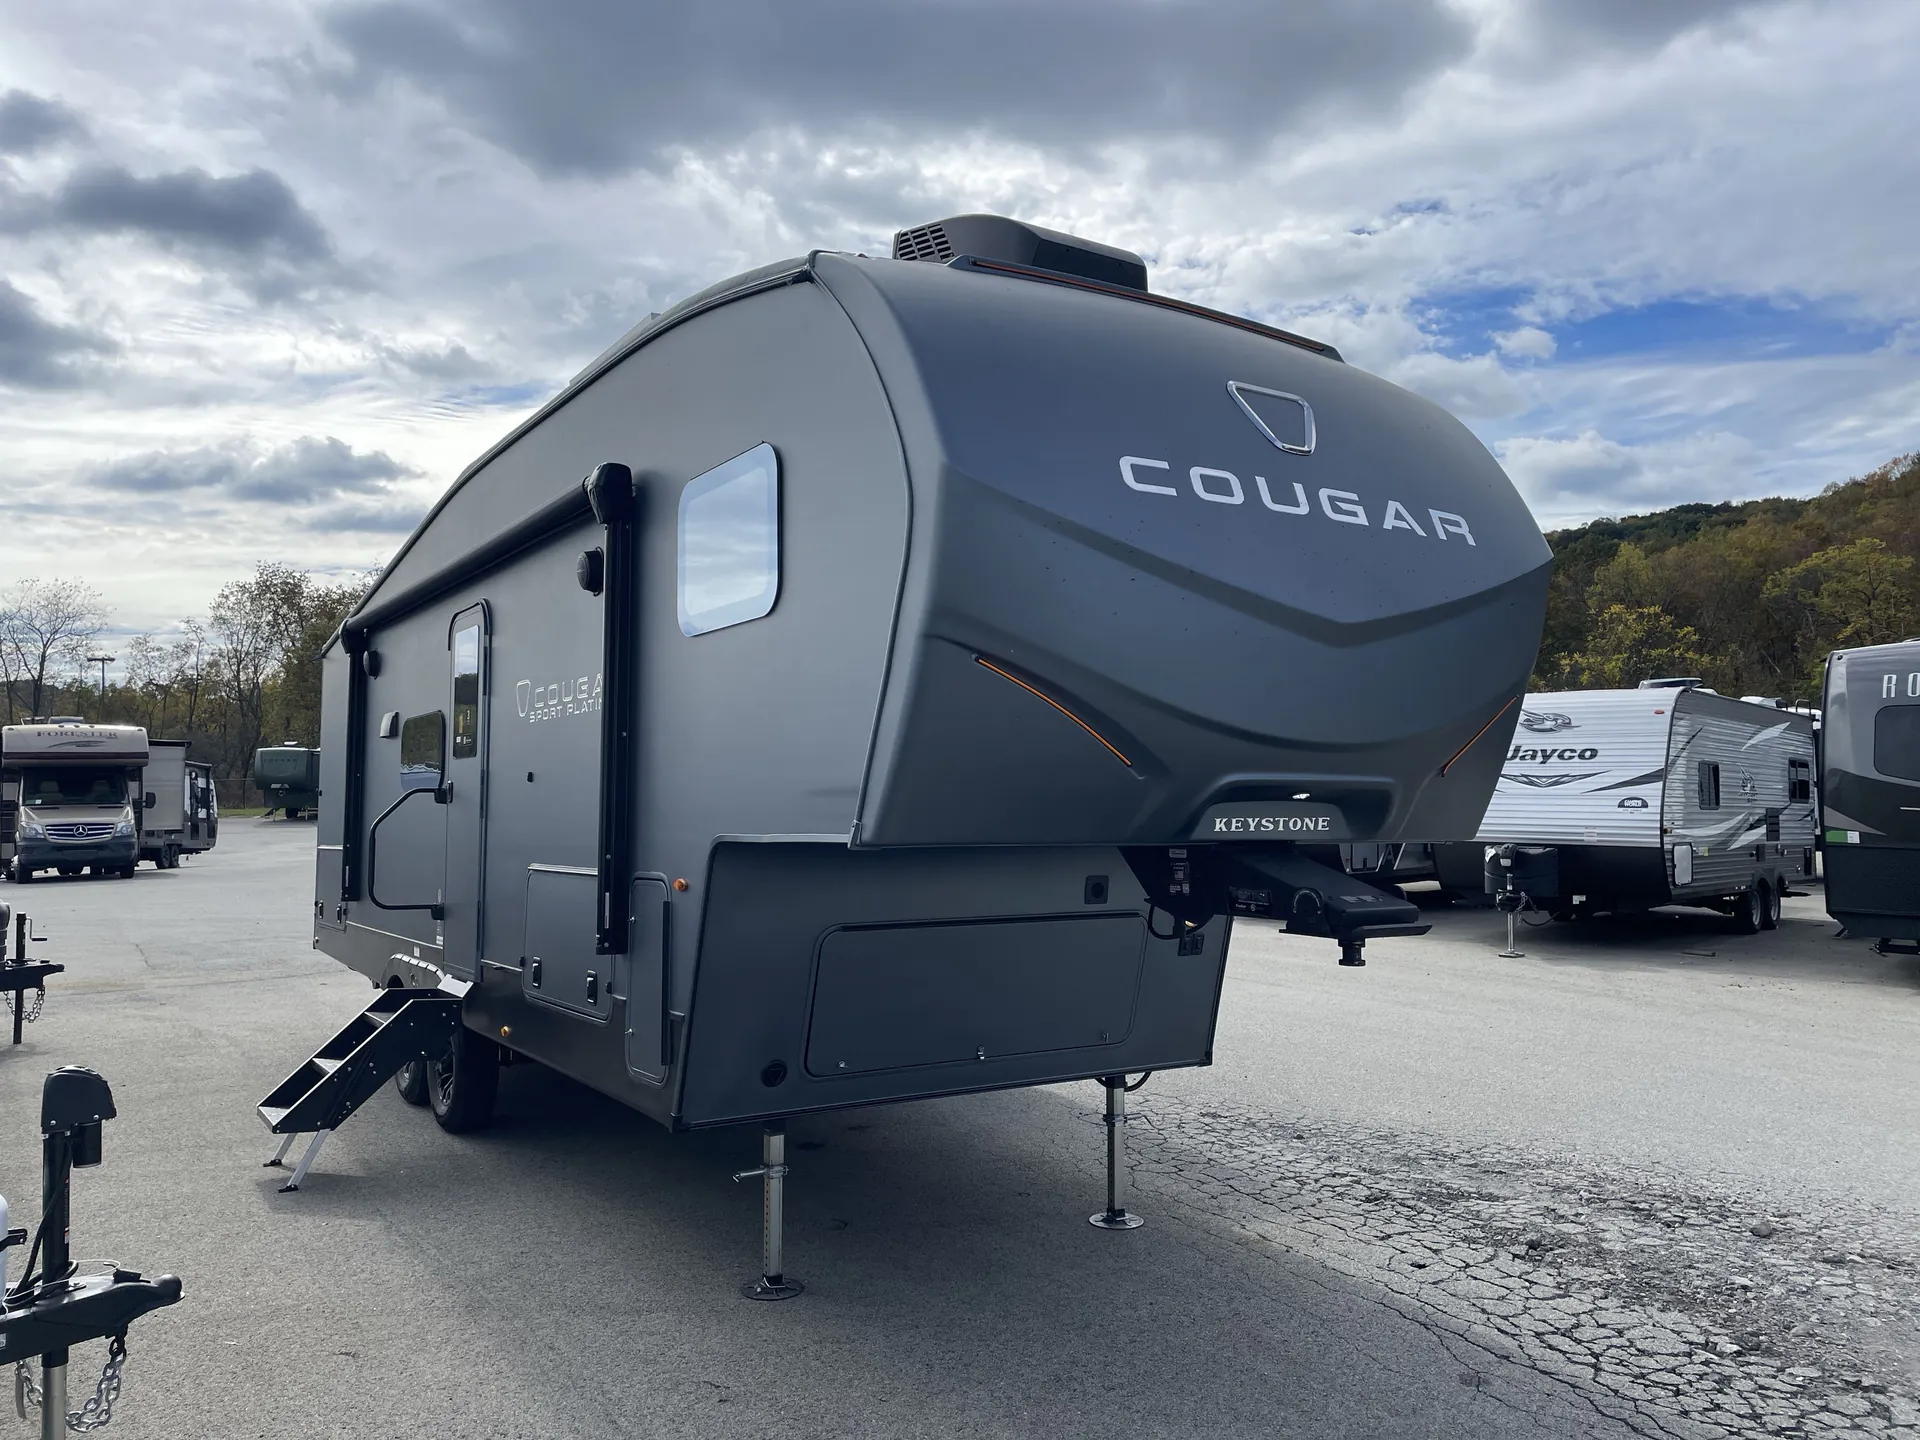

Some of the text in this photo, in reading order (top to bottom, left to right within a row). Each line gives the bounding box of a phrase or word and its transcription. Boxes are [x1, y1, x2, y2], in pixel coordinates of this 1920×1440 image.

[1119, 455, 1477, 546] COUGAR
[529, 706, 563, 723] SPORT
[1506, 745, 1599, 764] Jayco
[1213, 817, 1330, 832] KEYSTONE
